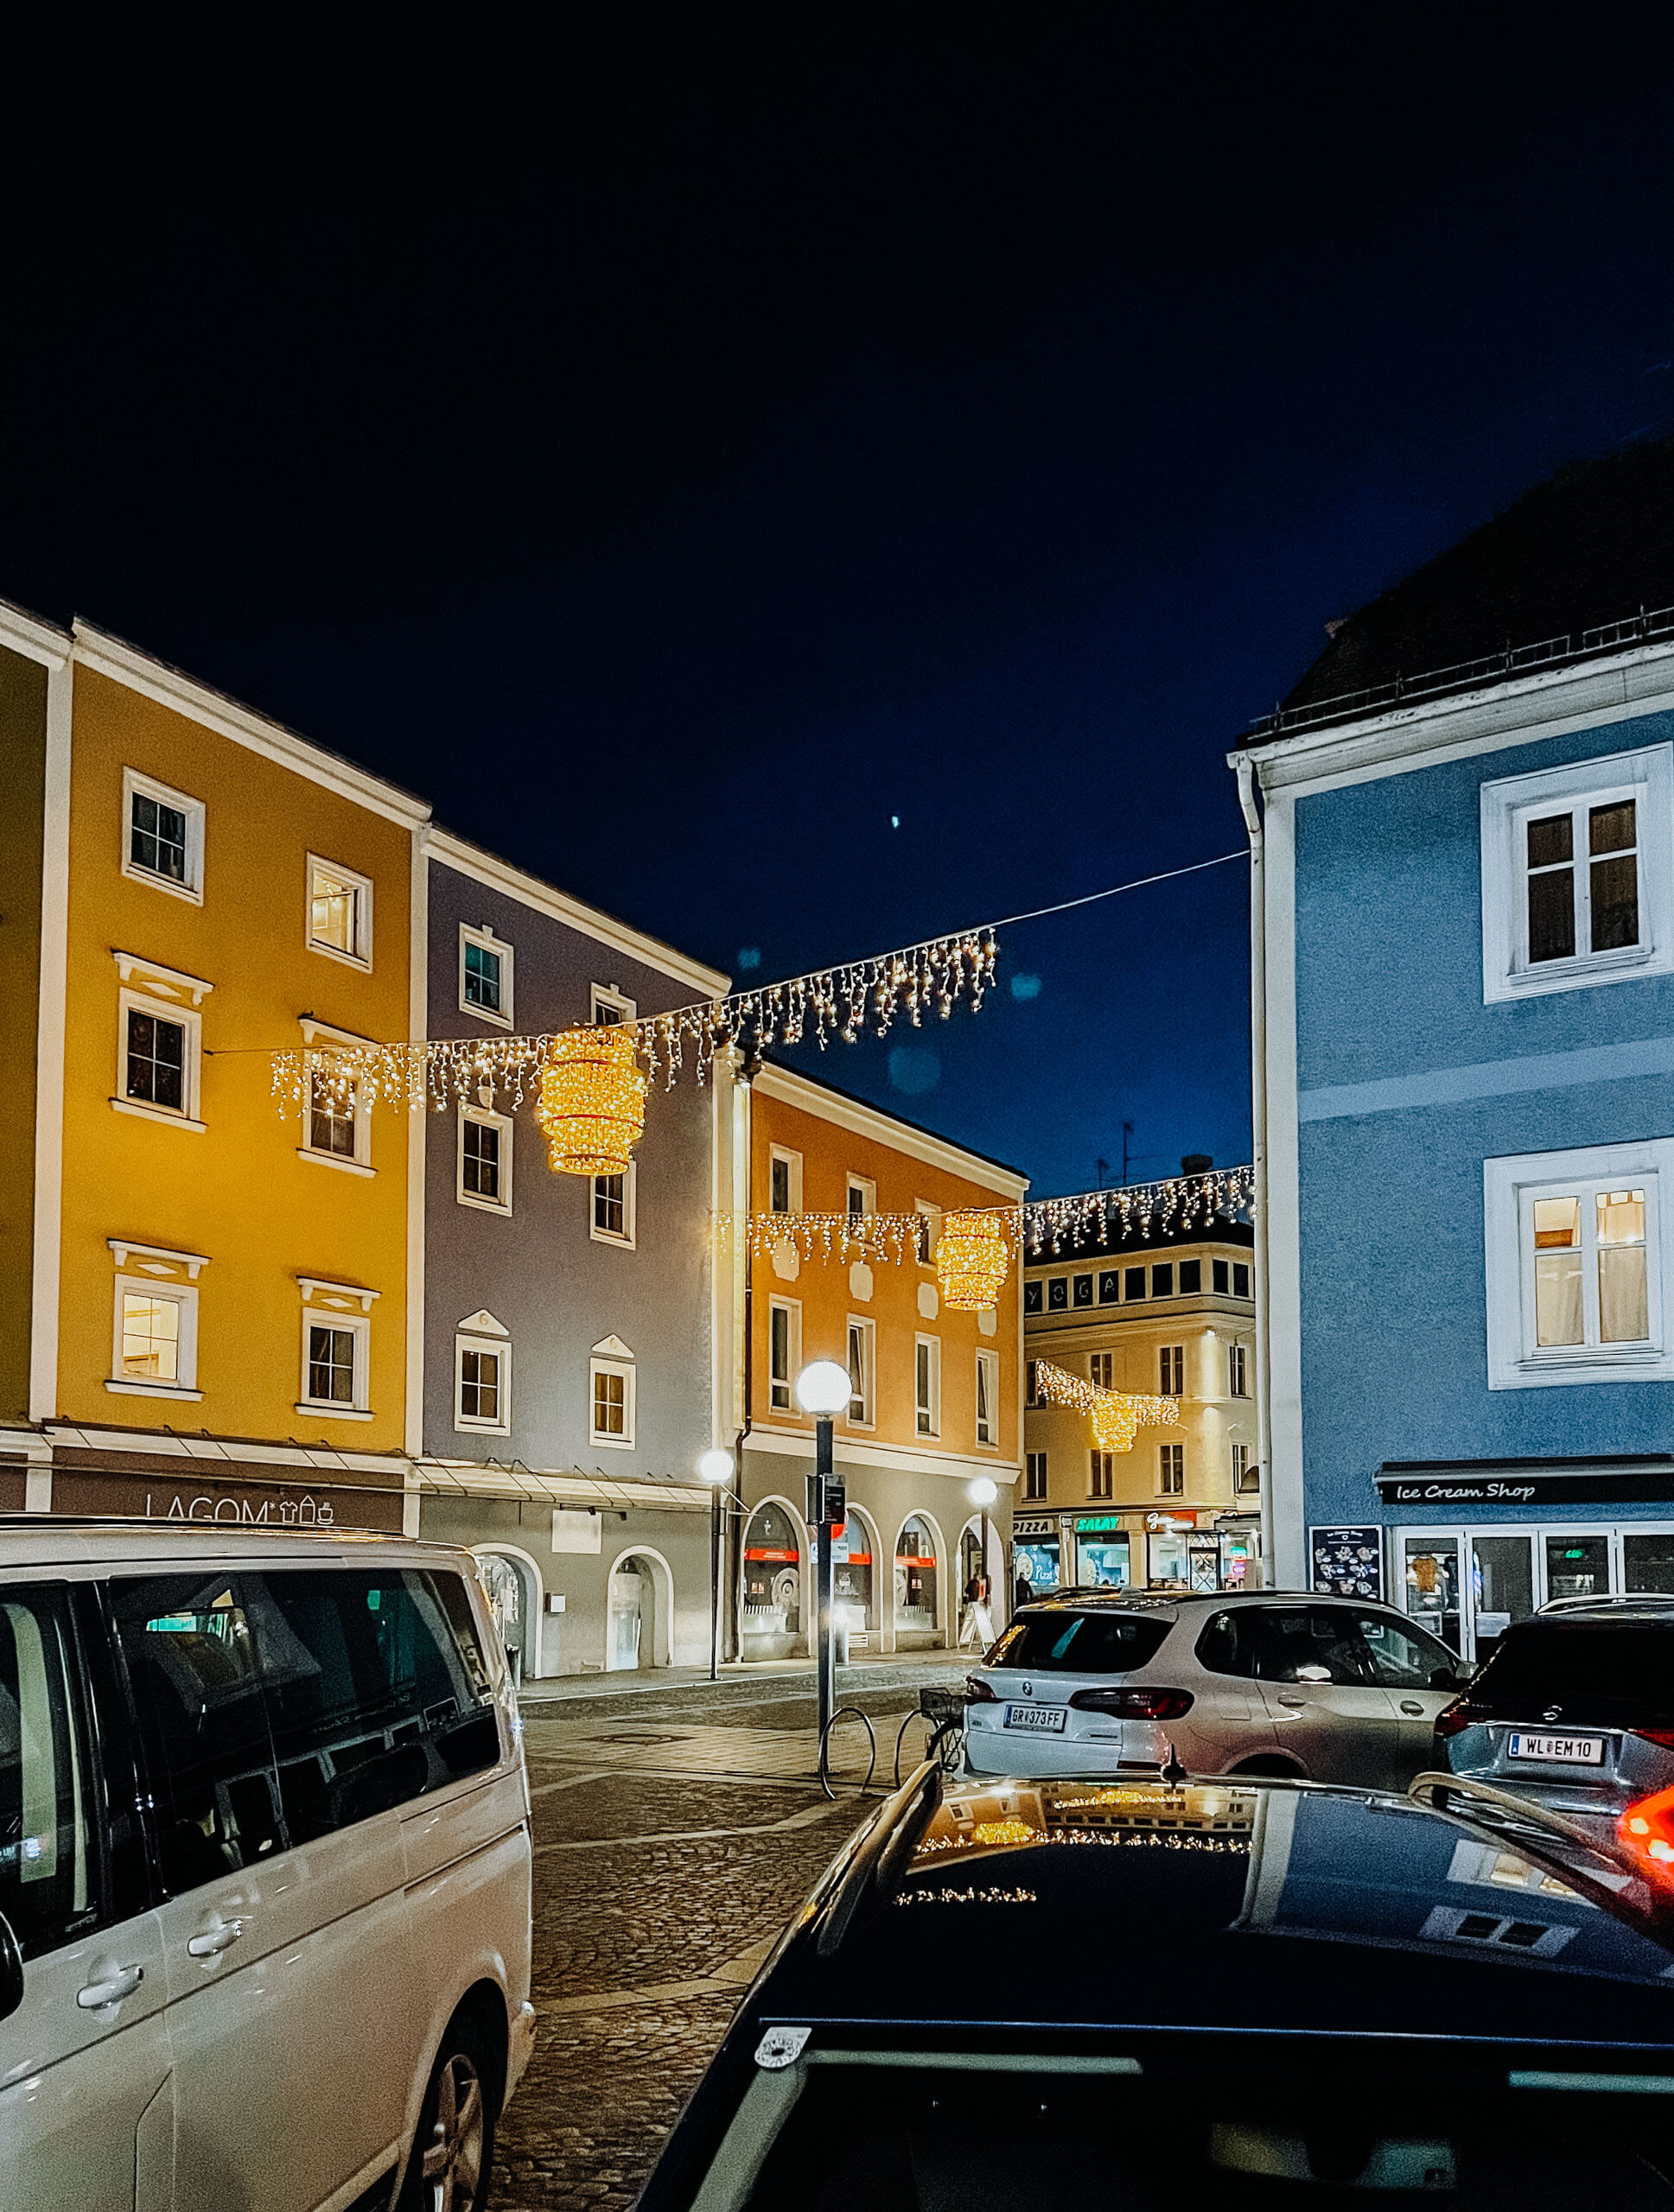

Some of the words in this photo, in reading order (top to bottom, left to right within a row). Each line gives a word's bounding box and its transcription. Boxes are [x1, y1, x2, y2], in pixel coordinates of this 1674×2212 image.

[1028, 1278, 1115, 1306] YOGA
[1397, 1485, 1422, 1499] Ice
[1425, 1484, 1484, 1498] Cream
[1486, 1483, 1536, 1501] Shop
[1013, 1521, 1048, 1533] PIZZA
[1077, 1516, 1119, 1531] SALAT
[1013, 1709, 1023, 1722] GR
[1526, 1738, 1544, 1754] WL
